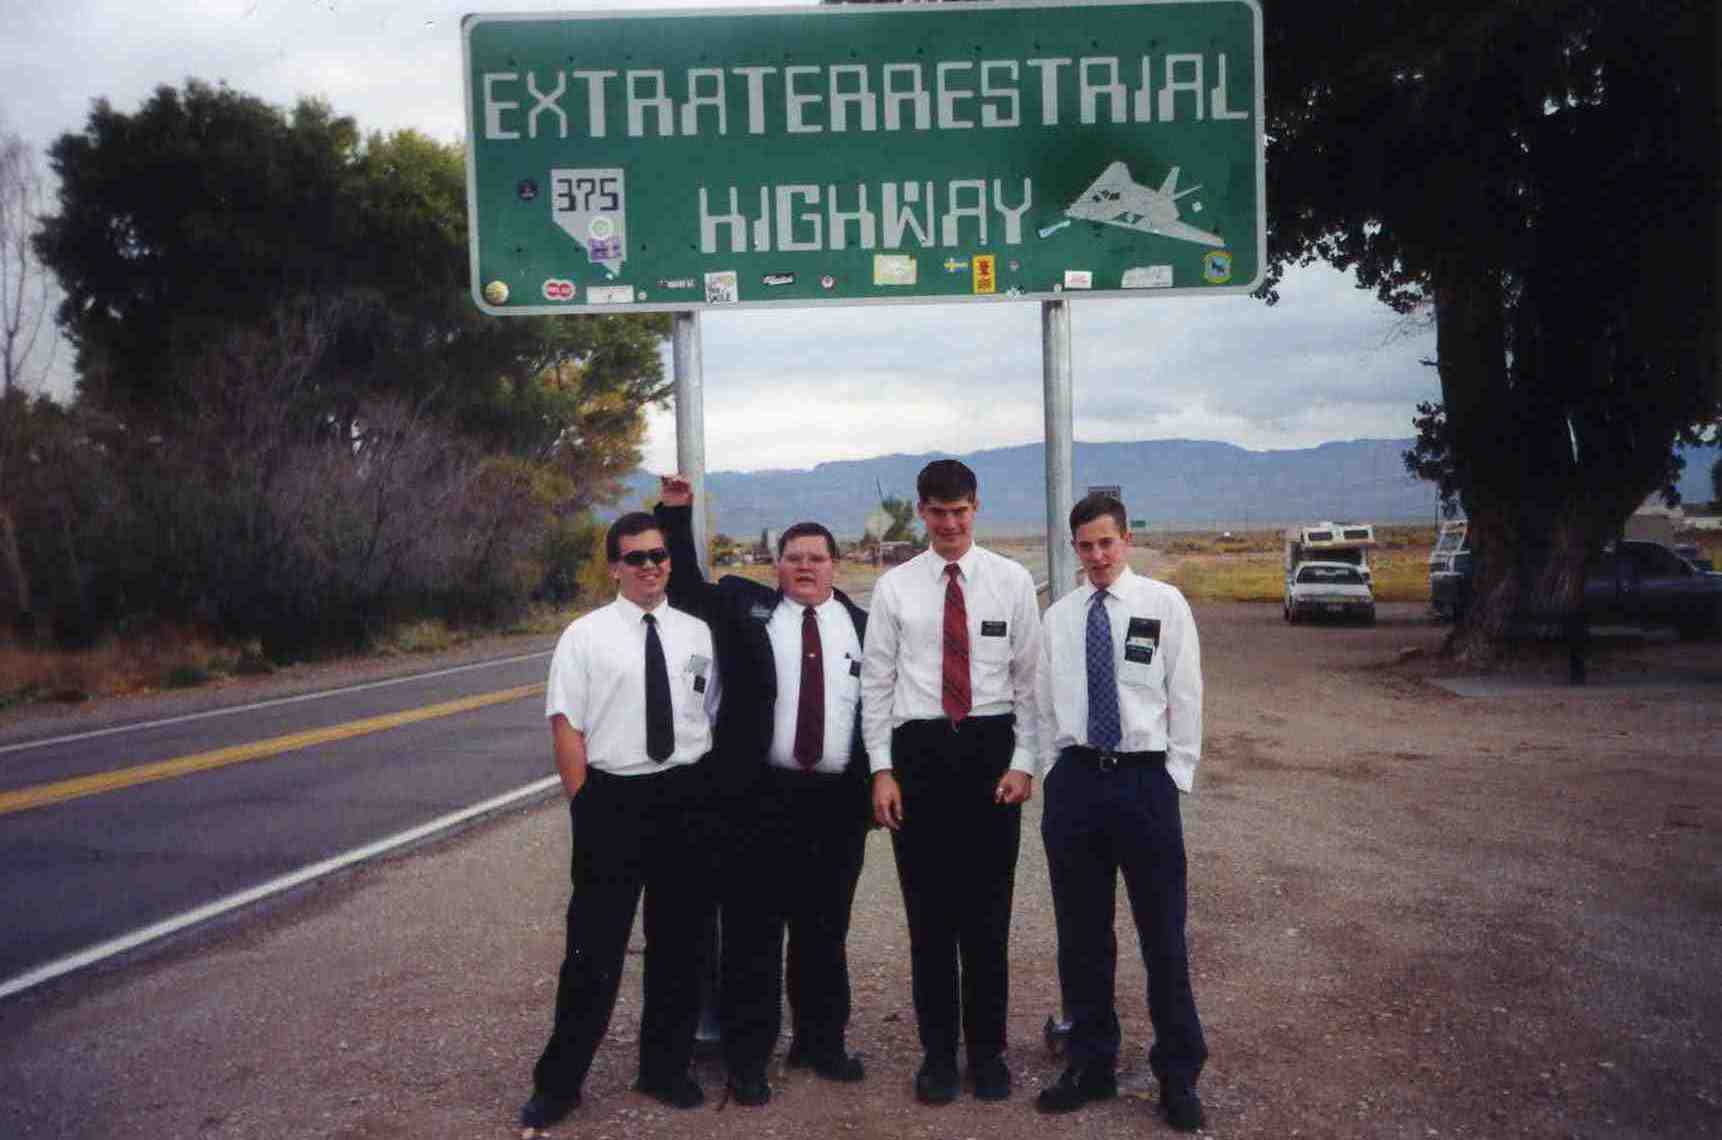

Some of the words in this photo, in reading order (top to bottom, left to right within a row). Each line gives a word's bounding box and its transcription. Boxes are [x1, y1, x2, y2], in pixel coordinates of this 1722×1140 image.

[484, 53, 1249, 140] EXTRATERRESTRIAL
[556, 178, 619, 212] 375
[700, 178, 1032, 253] HIGHWAY
